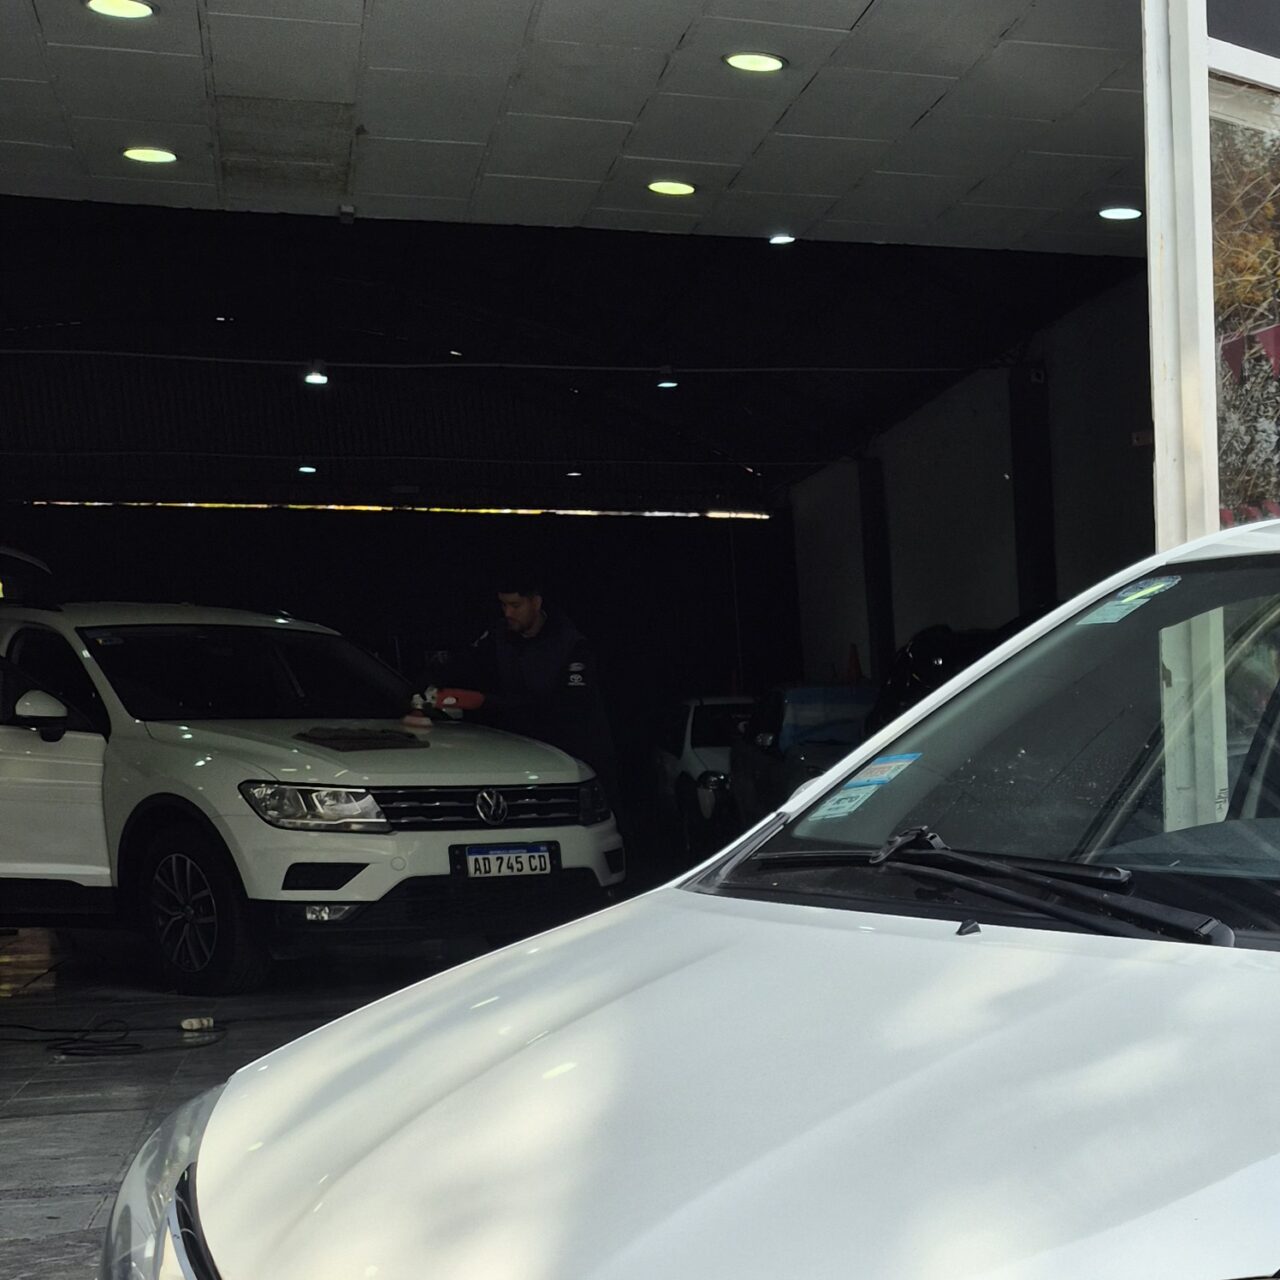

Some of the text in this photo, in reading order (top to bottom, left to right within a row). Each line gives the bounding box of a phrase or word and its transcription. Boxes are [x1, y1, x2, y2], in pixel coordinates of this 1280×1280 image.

[474, 854, 547, 875] AD 745 CD
